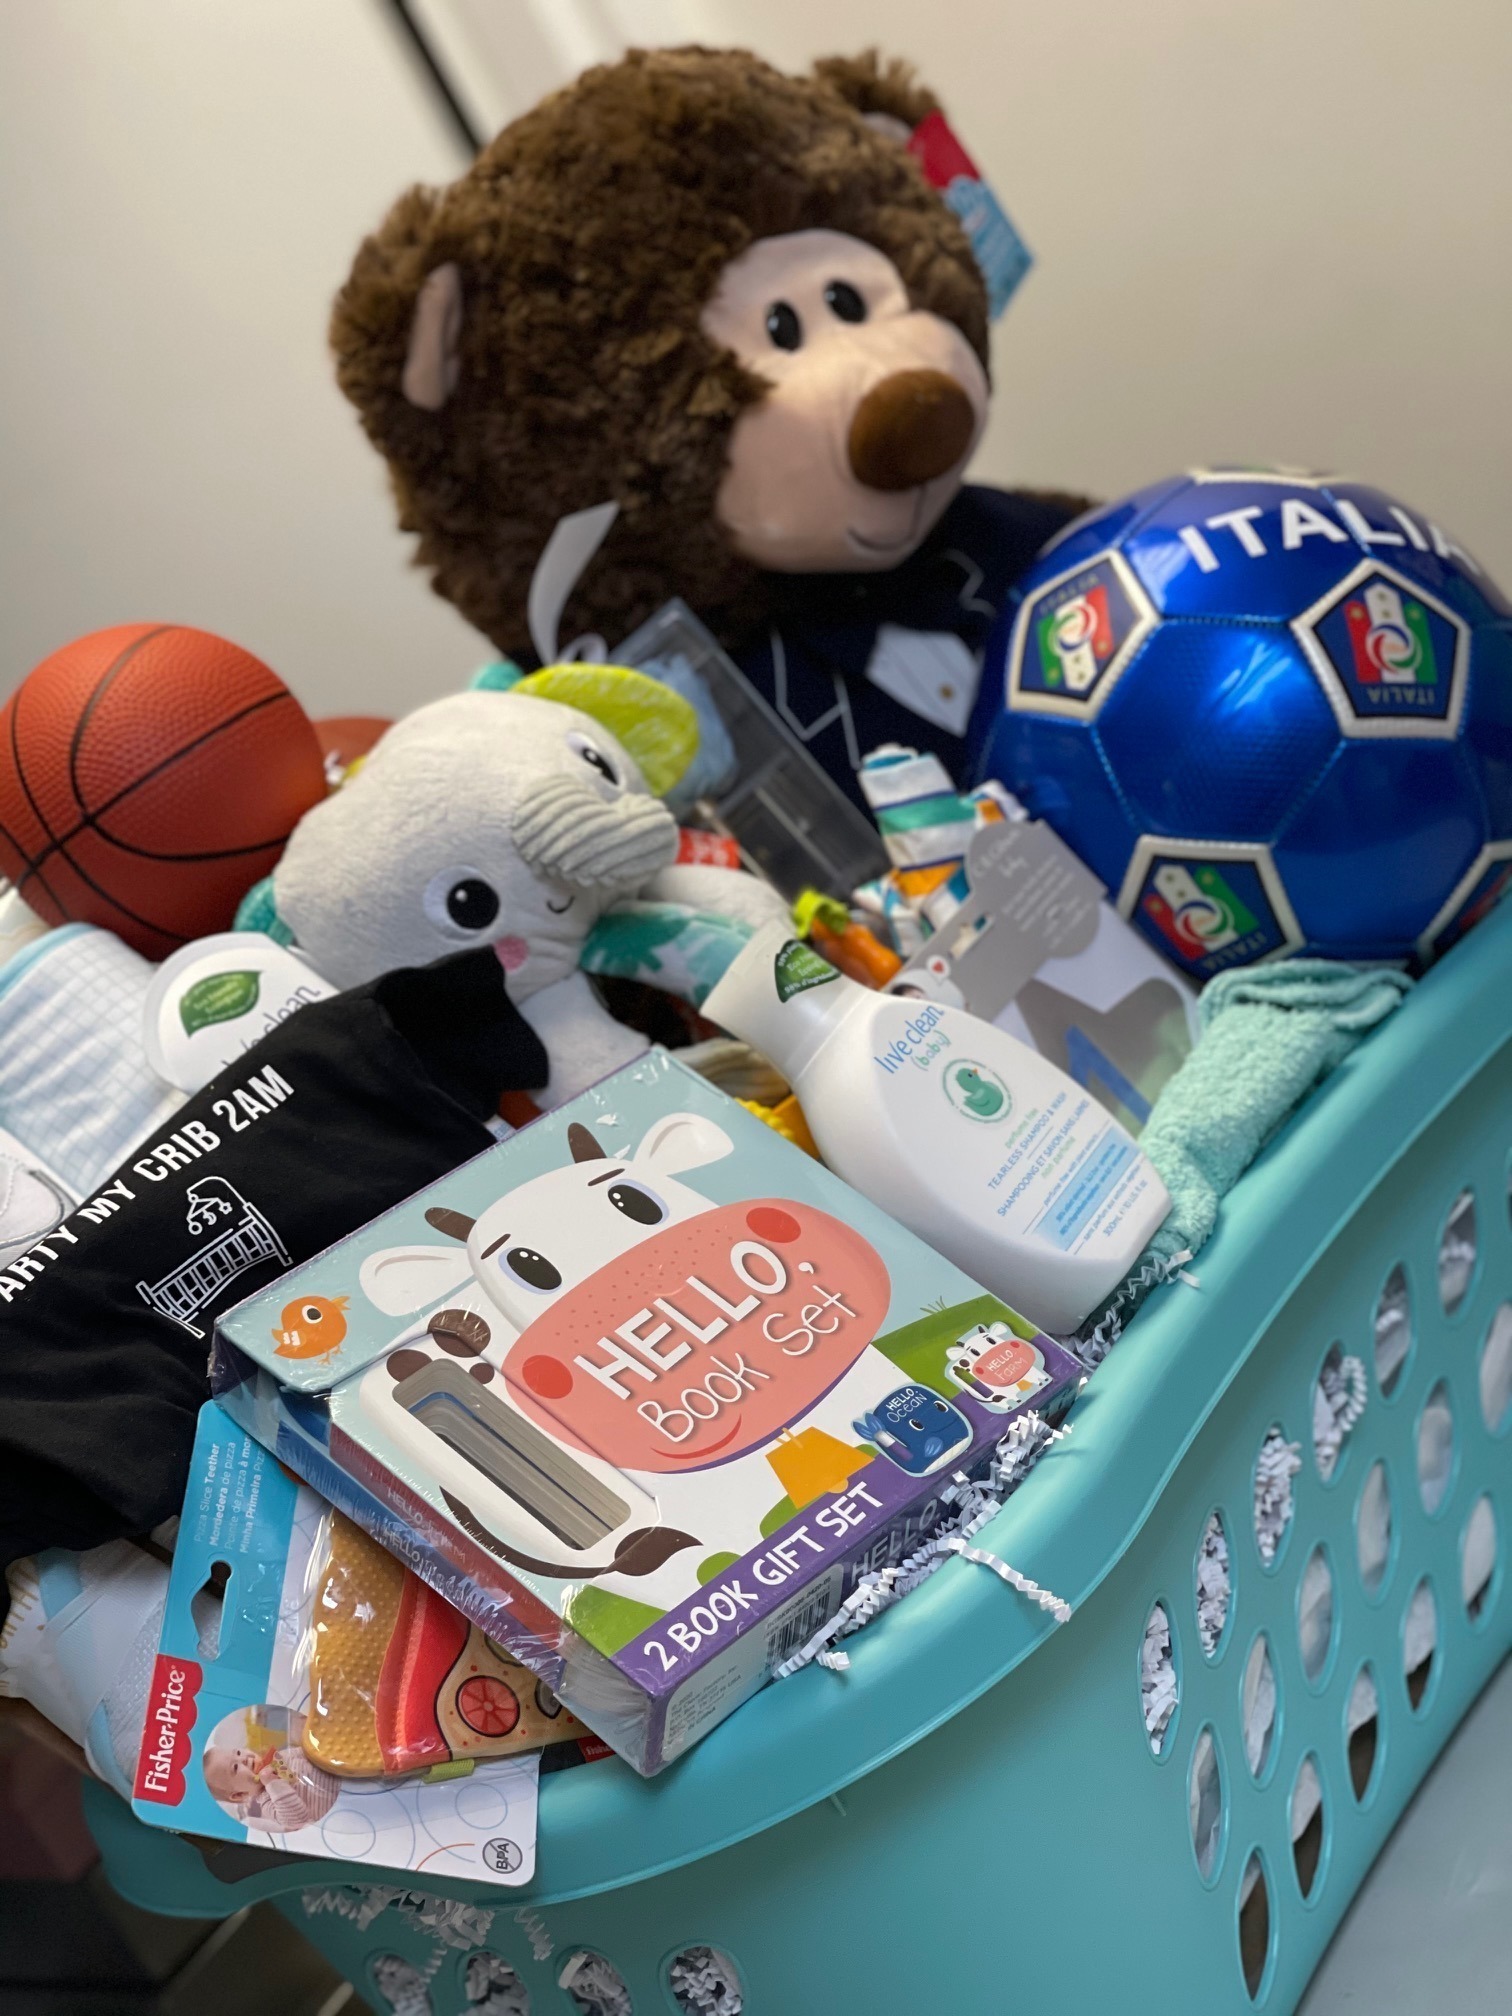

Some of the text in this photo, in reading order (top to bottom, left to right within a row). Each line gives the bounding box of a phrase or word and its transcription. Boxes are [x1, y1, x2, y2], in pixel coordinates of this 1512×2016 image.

[1178, 499, 1481, 576] ITALIA
[873, 1005, 945, 1074] live clean
[77, 1179, 136, 1224] MY
[133, 1120, 221, 1182] CRIB
[212, 1064, 295, 1133] 2AM
[987, 1148, 1023, 1190] TEARLESS
[1020, 1114, 1050, 1150] SHAMPOO
[997, 1165, 1039, 1217] SHAMPOOING
[1035, 1154, 1047, 1167] ET
[1043, 1133, 1064, 1157] SAVON
[573, 1240, 814, 1400] HELLO,
[636, 1285, 856, 1443] Book Set
[204, 1443, 220, 1484] Teether
[236, 1469, 248, 1497] pizza
[241, 1437, 252, 1459] mor
[200, 1486, 213, 1512] Slice
[209, 1441, 236, 1547] Mordedera de pizza
[232, 1499, 242, 1513] de
[240, 1450, 266, 1554] Minha Primeira Pizz
[643, 1640, 679, 1671] 2
[667, 1579, 759, 1653] BOOK
[752, 1525, 825, 1585] GIFT
[815, 1481, 883, 1537] SET
[144, 1668, 186, 1793] Fisher-Price
[496, 1843, 509, 1870] BPA
